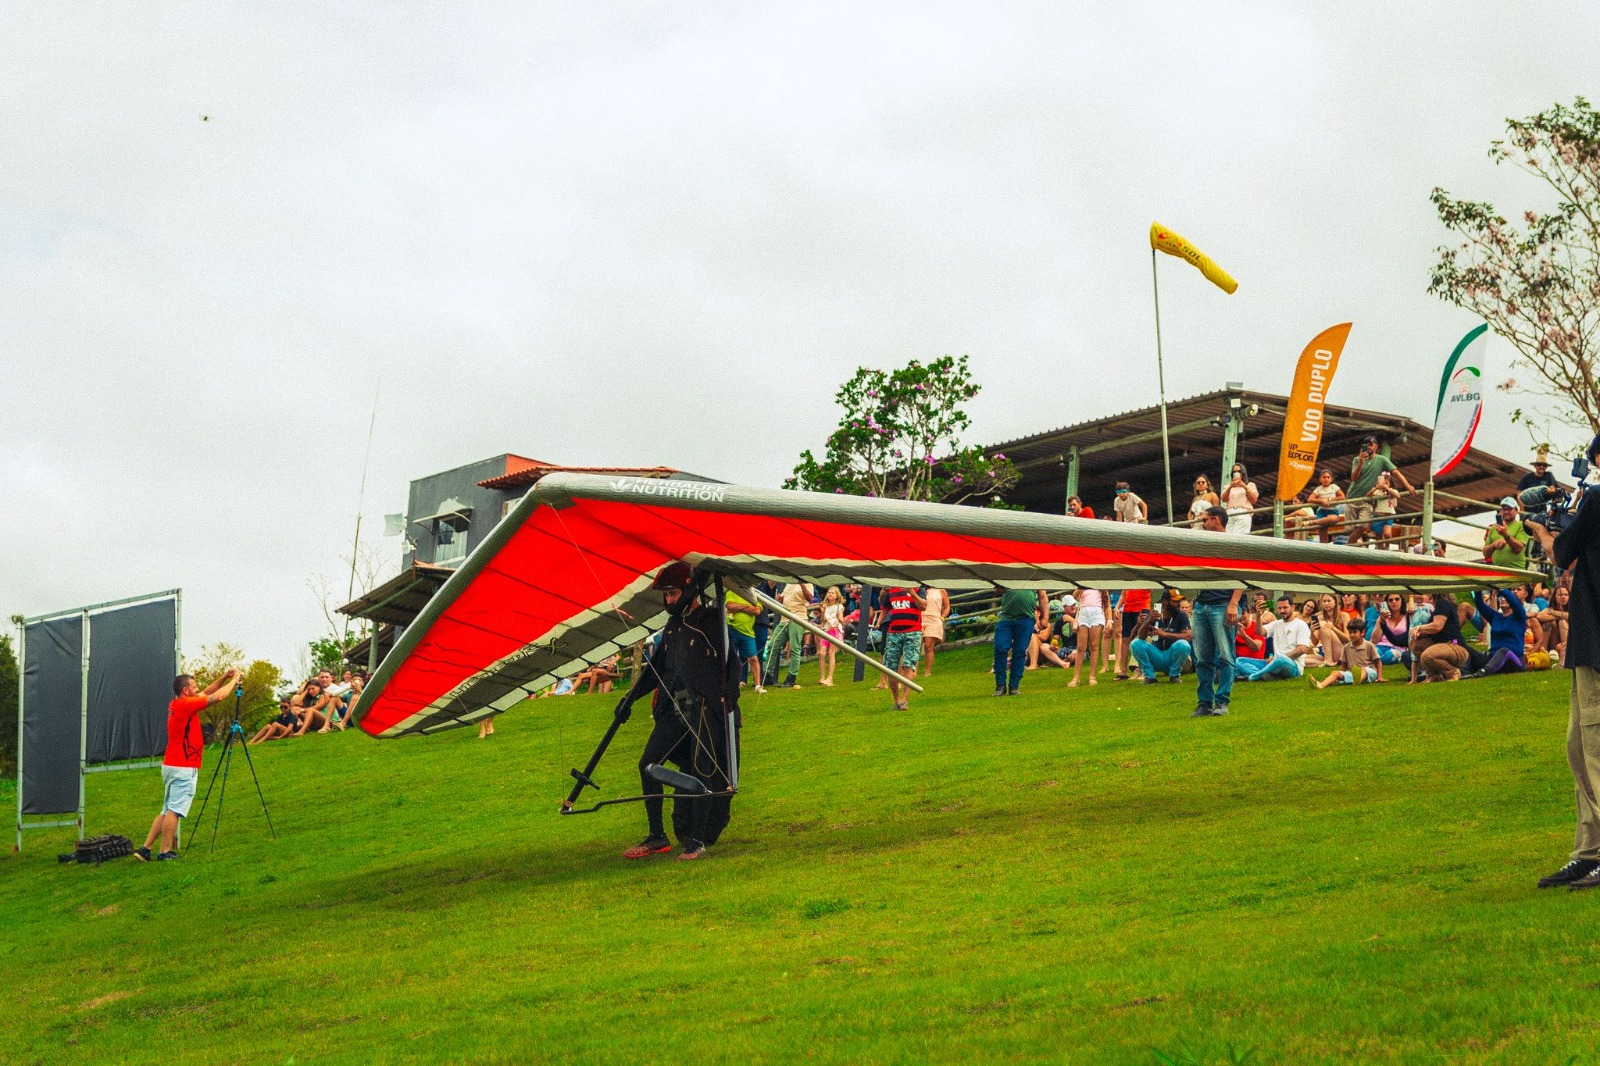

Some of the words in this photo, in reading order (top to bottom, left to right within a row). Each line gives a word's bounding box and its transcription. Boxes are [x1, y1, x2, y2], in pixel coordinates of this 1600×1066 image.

[1308, 349, 1333, 404] DUPLO
[1451, 392, 1480, 402] AVLBG
[1300, 408, 1322, 442] VOO
[631, 483, 725, 503] NUTRITION
